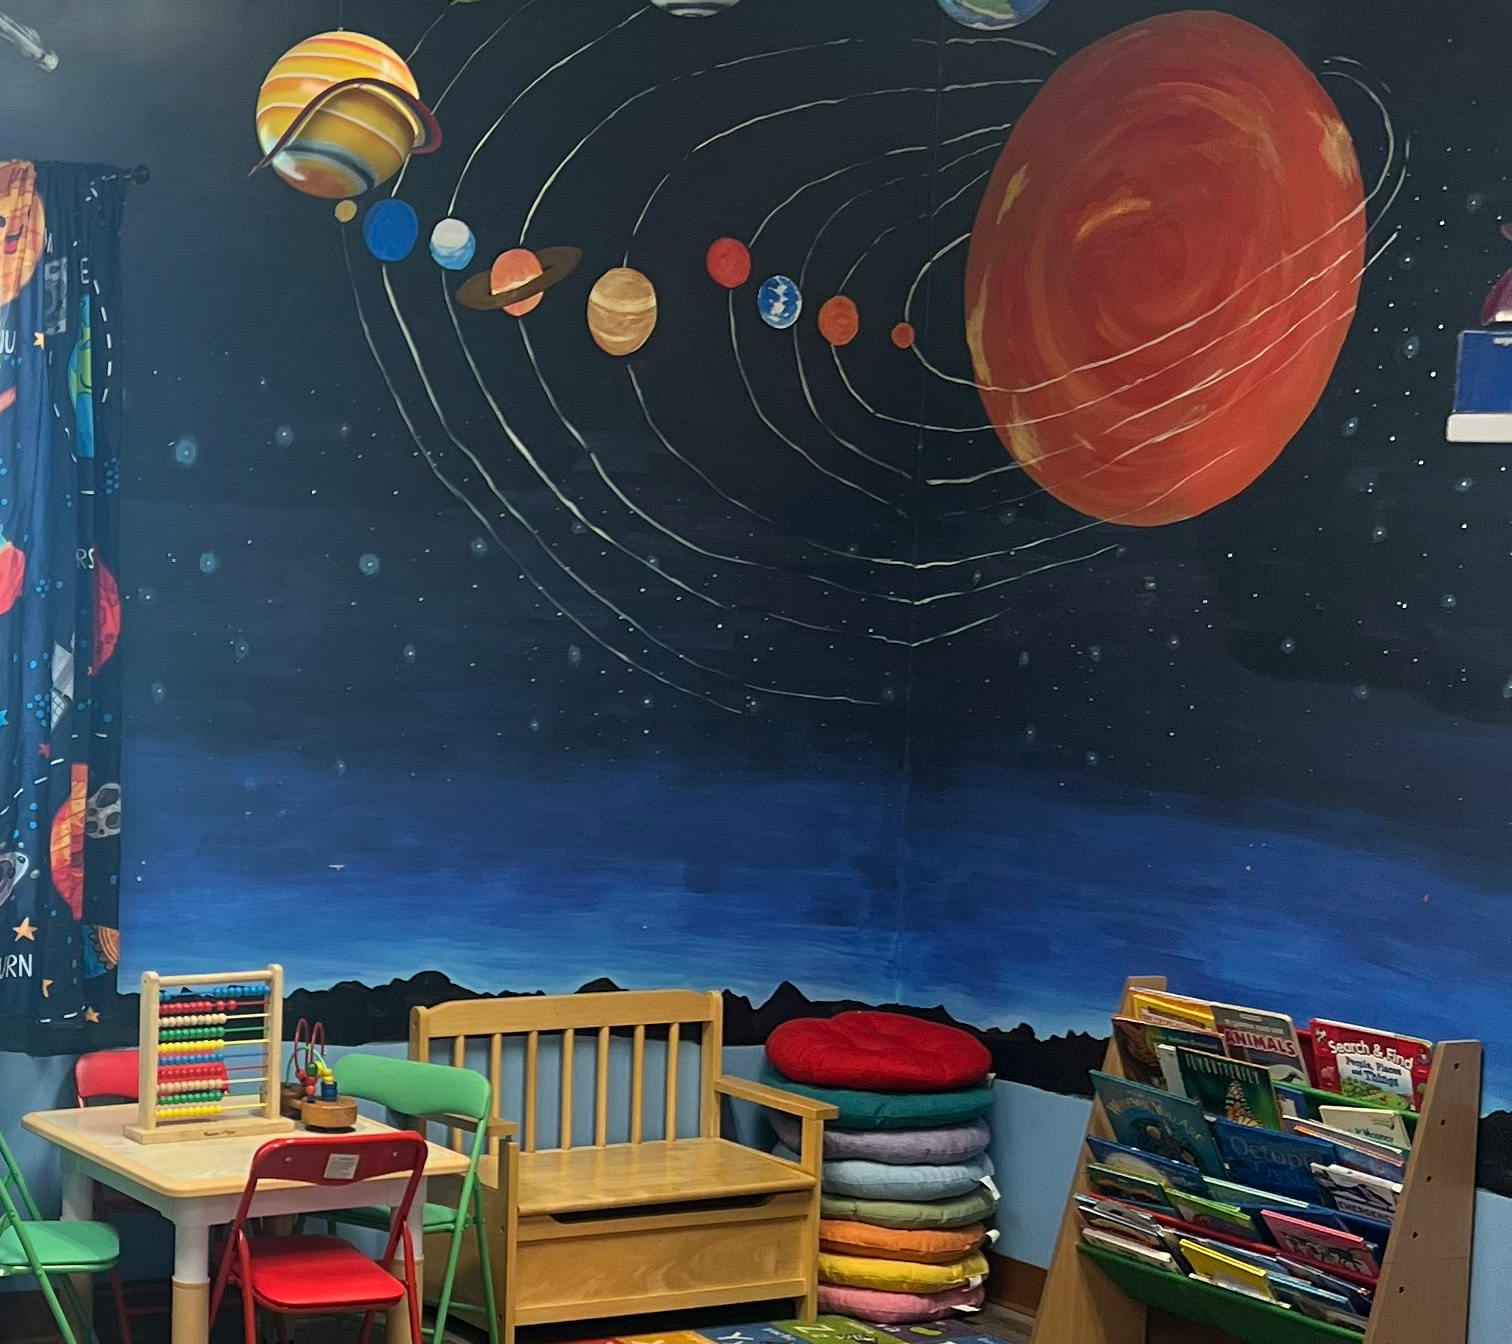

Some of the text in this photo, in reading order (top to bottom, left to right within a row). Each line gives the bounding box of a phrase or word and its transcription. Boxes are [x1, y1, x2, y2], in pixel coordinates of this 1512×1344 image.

[1224, 1029, 1297, 1058] ANIMALS
[1328, 1039, 1370, 1056] Search
[1386, 1047, 1414, 1070] Find
